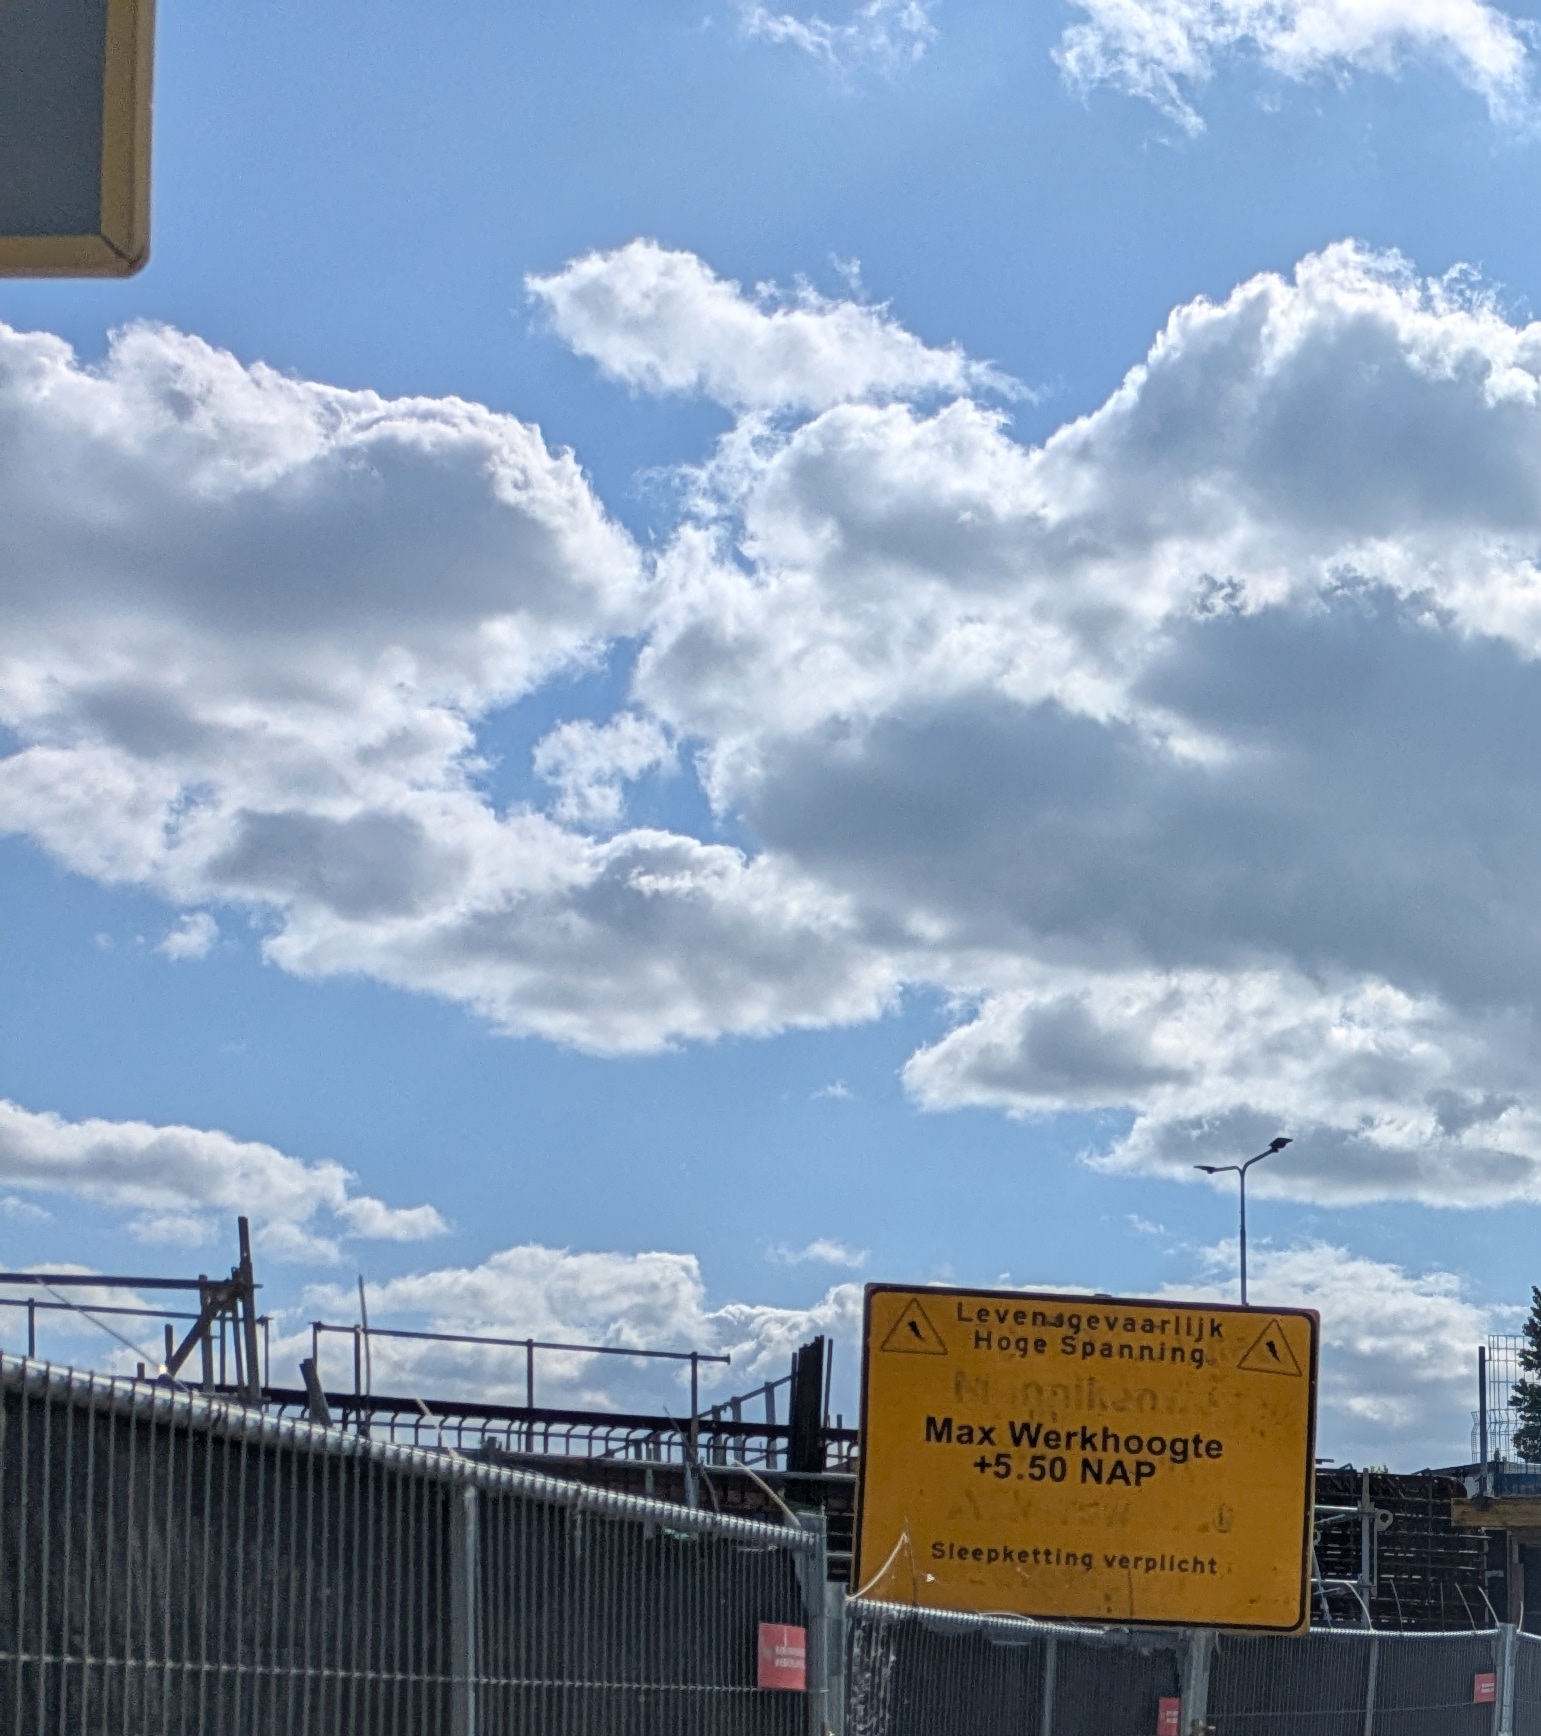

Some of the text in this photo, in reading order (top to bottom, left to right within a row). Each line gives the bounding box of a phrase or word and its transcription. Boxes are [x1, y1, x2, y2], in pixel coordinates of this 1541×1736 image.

[974, 1332, 1205, 1368] Hoge Spanning
[925, 1416, 1223, 1463] Max Werkhoogte
[974, 1454, 1156, 1486] +5.50 NAP
[931, 1542, 1217, 1575] Sleepketting verplicht
